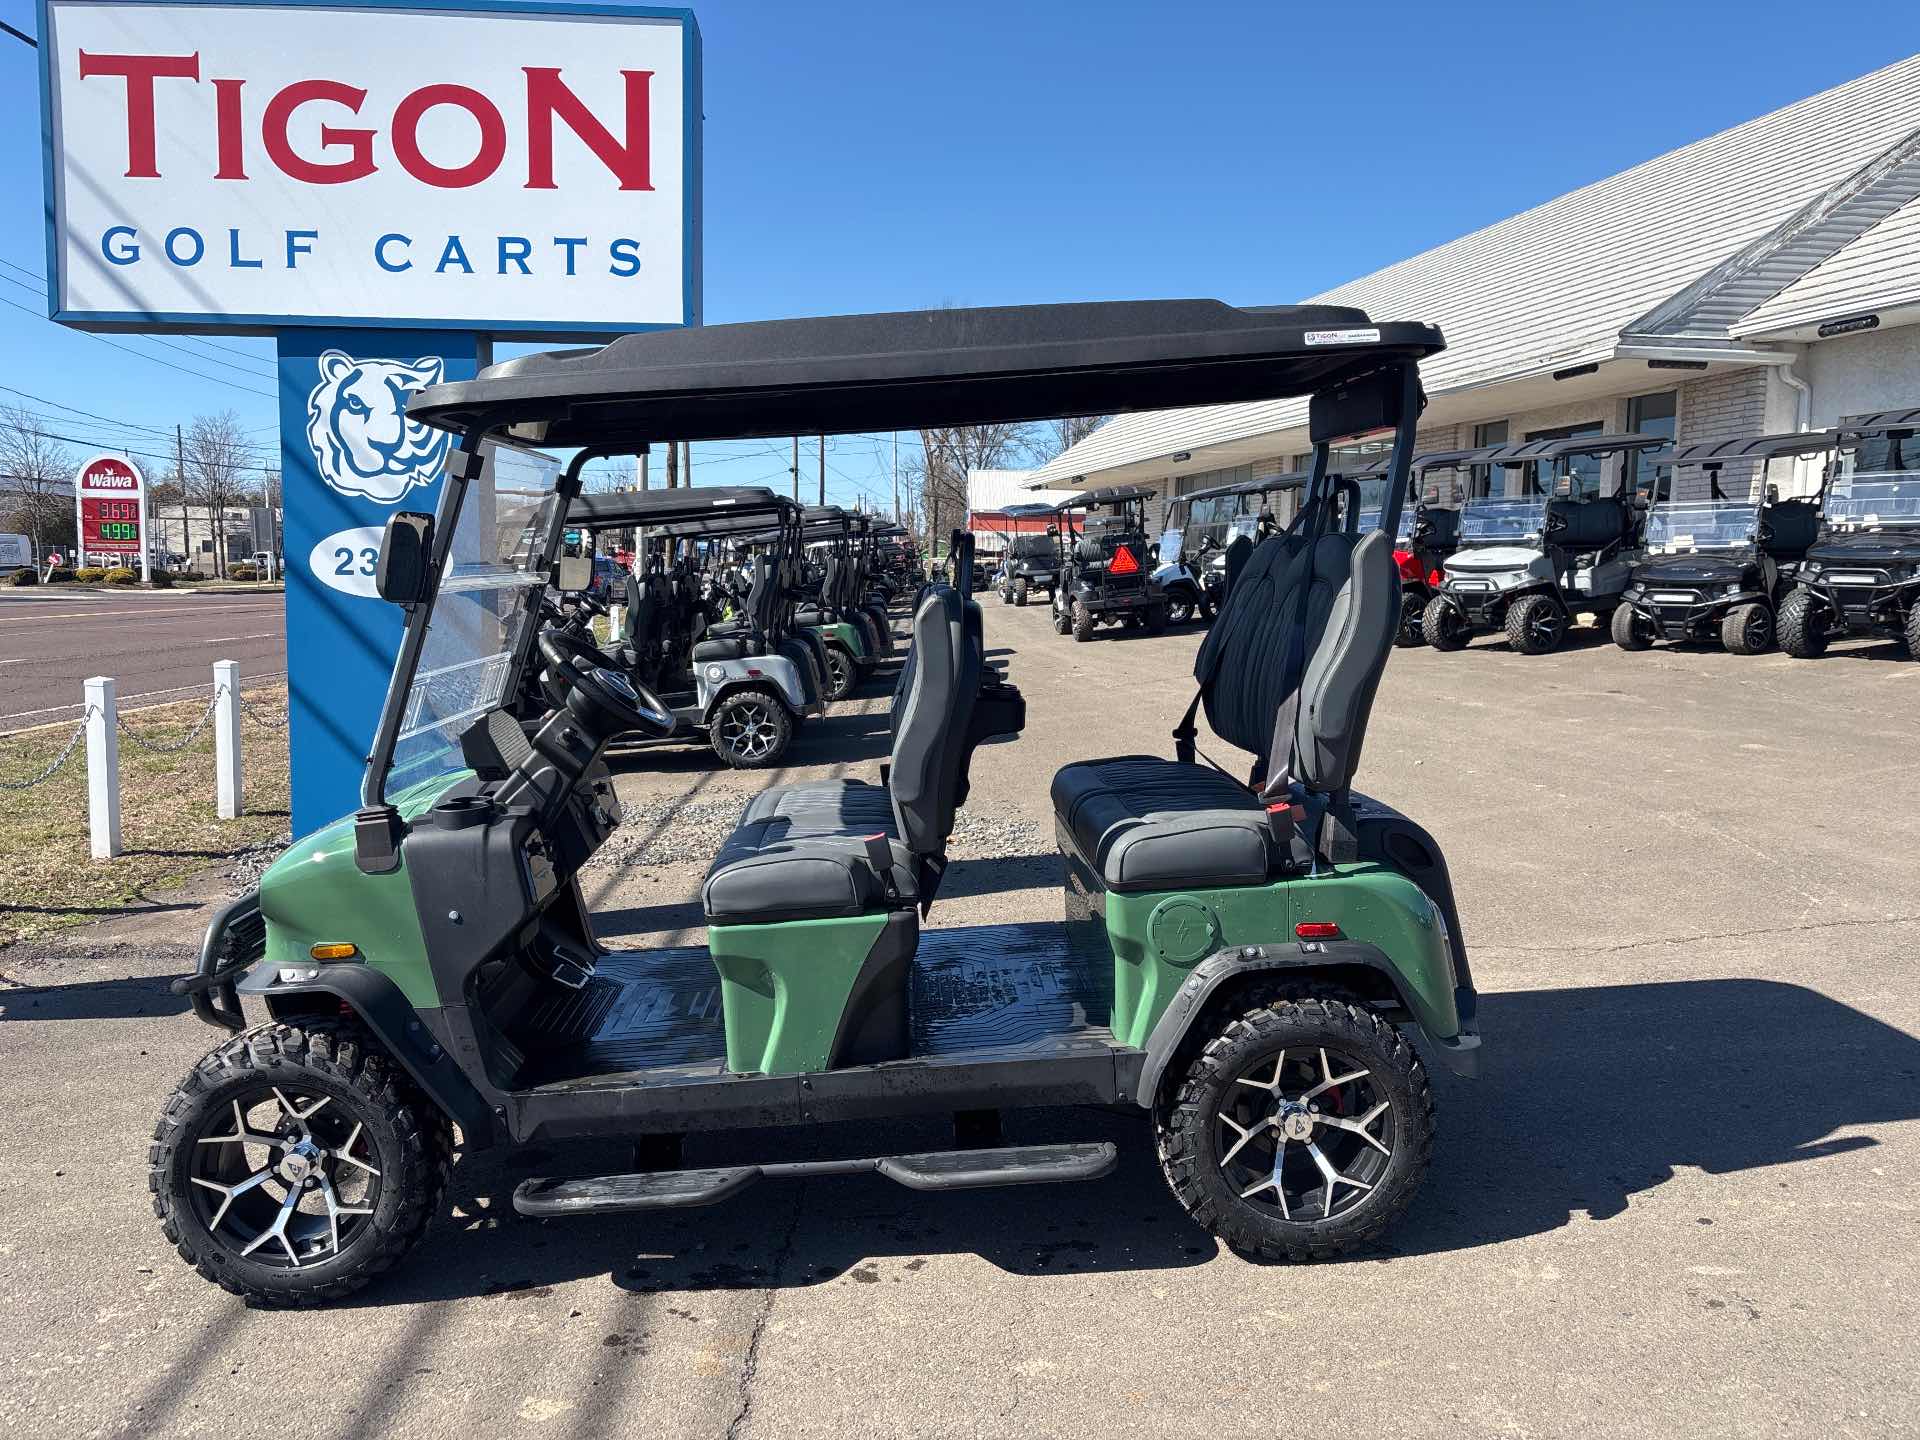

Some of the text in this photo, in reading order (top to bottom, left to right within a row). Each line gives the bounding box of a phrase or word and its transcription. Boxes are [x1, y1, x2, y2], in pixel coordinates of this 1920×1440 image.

[79, 47, 656, 192] TIGON
[101, 225, 642, 278] GOLF CARTS
[88, 473, 132, 488] Wawa
